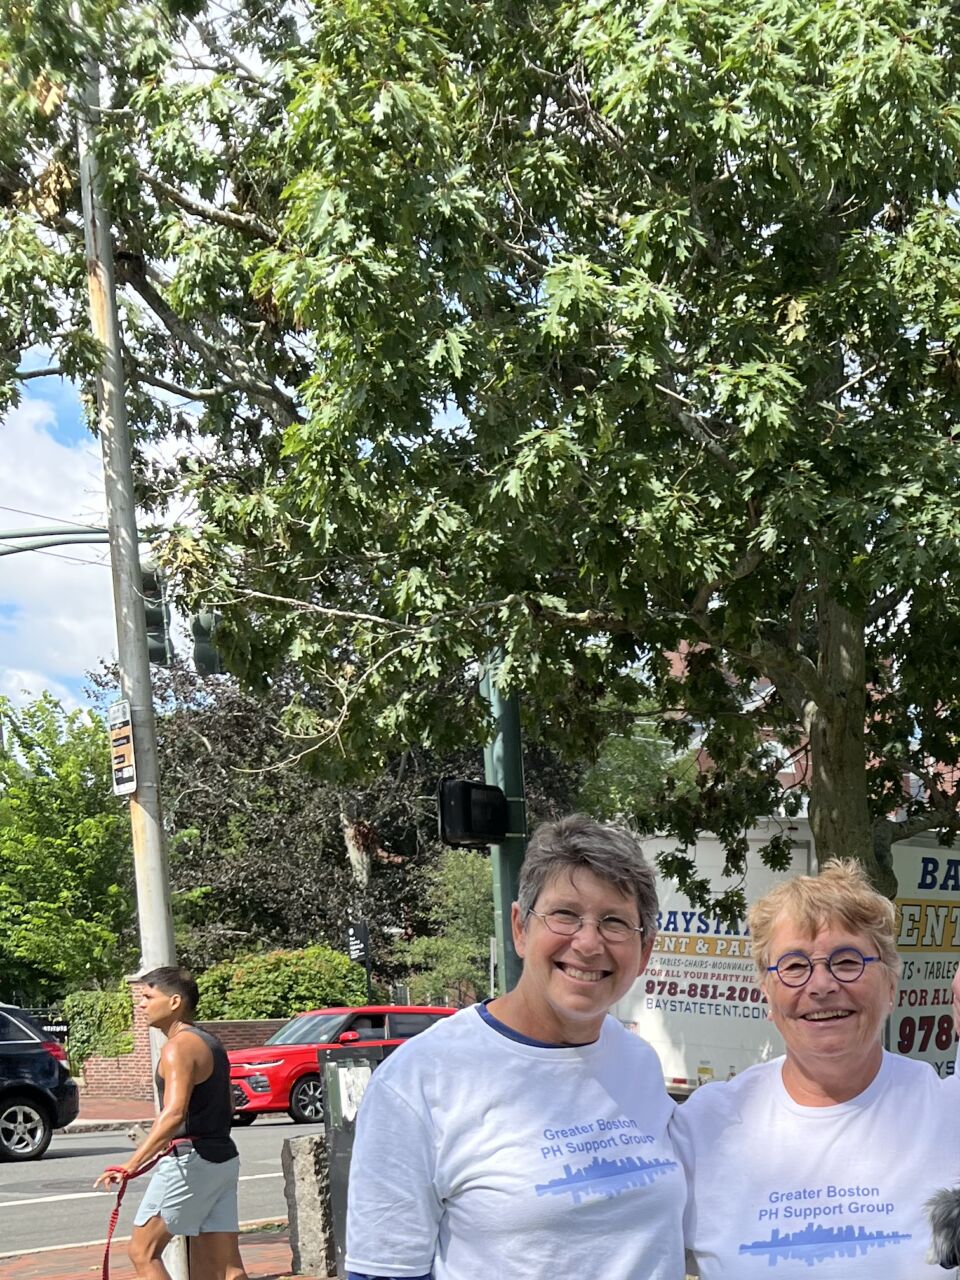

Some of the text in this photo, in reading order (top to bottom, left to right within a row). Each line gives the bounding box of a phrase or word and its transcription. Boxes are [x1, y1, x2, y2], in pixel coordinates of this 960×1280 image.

[652, 936, 752, 956] ENT & PAR
[645, 969, 662, 977] FOR
[664, 970, 681, 978] ALL
[683, 971, 709, 980] YOUR
[710, 972, 741, 982] PARTY
[898, 989, 930, 1007] FOR
[543, 1119, 638, 1140] Greater Boston
[541, 1133, 655, 1159] PH Support Group
[769, 1185, 880, 1203] Greater Boston
[759, 1202, 895, 1220] PH Support Group
